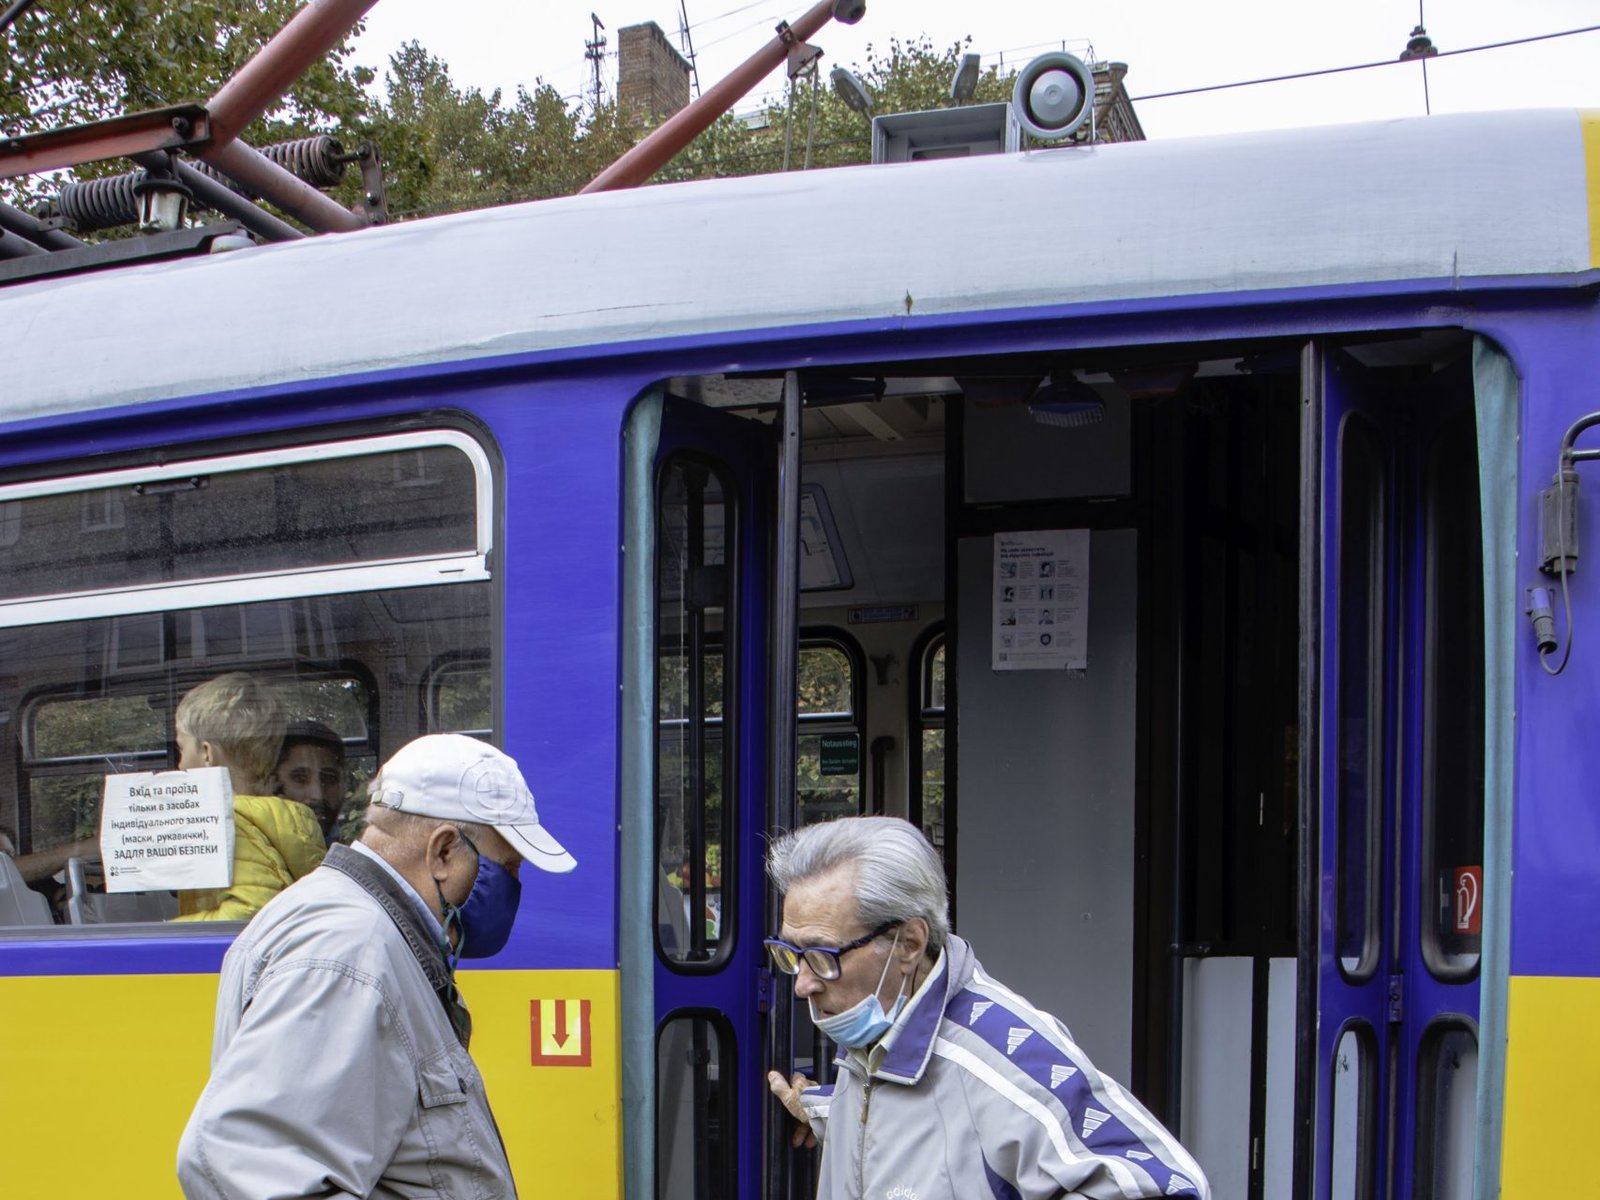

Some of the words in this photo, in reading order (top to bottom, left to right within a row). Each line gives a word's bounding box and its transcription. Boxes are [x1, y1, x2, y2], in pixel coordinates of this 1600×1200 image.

[129, 786, 151, 797] Вхід
[153, 787, 163, 796] та
[165, 783, 198, 796] проїзд
[128, 803, 157, 813] тільки
[158, 803, 164, 811] в
[166, 799, 200, 811] засобах
[111, 817, 184, 829] індивідуального
[186, 815, 219, 824] захисту
[121, 835, 154, 845] (маски,
[156, 829, 209, 844] рукавички),
[114, 848, 144, 860] ЗАДЛЯ
[146, 846, 177, 858] ВАШОЇ
[179, 844, 218, 856] БЕЗПЕКИ
